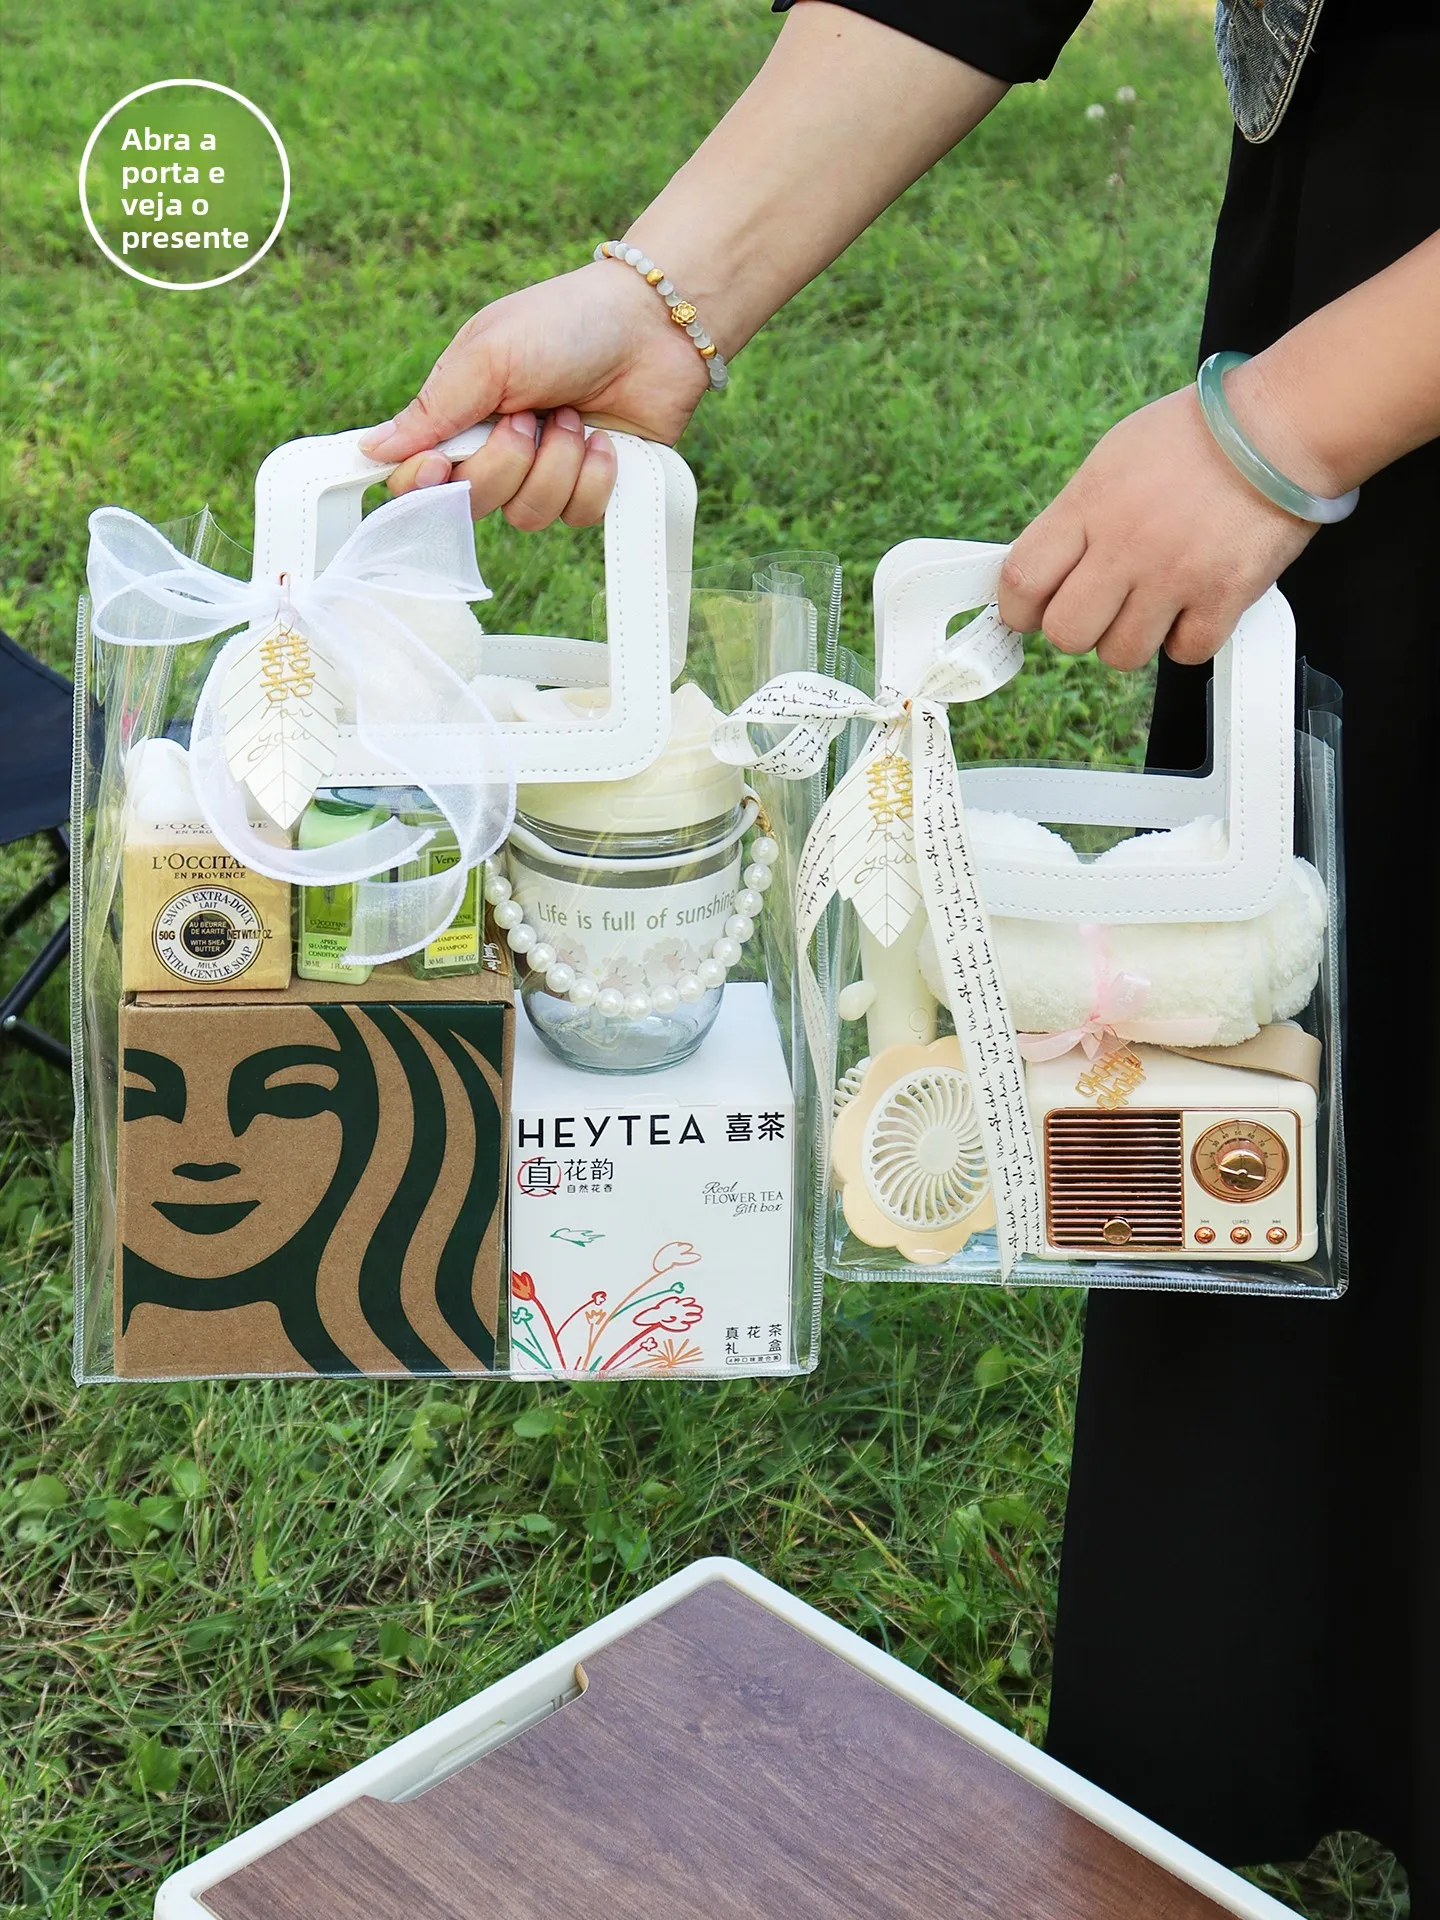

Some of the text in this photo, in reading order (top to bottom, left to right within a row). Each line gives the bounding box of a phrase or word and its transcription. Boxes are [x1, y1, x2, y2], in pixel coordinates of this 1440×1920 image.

[152, 853, 247, 870] L'OCCITA
[174, 872, 246, 880] EN PROVENCE
[163, 891, 255, 926] SAVON EXTRA-DOUX
[538, 901, 567, 926] Life
[577, 910, 592, 930] is
[602, 911, 635, 931] full
[646, 907, 668, 929] of
[159, 931, 176, 940] 50G
[226, 929, 240, 940] NET
[437, 944, 468, 952] SHAMPOO
[162, 946, 252, 979] EXTRA-GENTLE SOAP
[518, 1112, 785, 1148] HEYTEA 喜茶
[519, 1157, 613, 1196] 真花韵
[567, 1184, 612, 1193] 自然花香
[702, 1181, 738, 1194] Real
[704, 1190, 783, 1204] FLOWER TEA
[733, 1203, 782, 1217] Gift box
[725, 1339, 782, 1355] 礼盒
